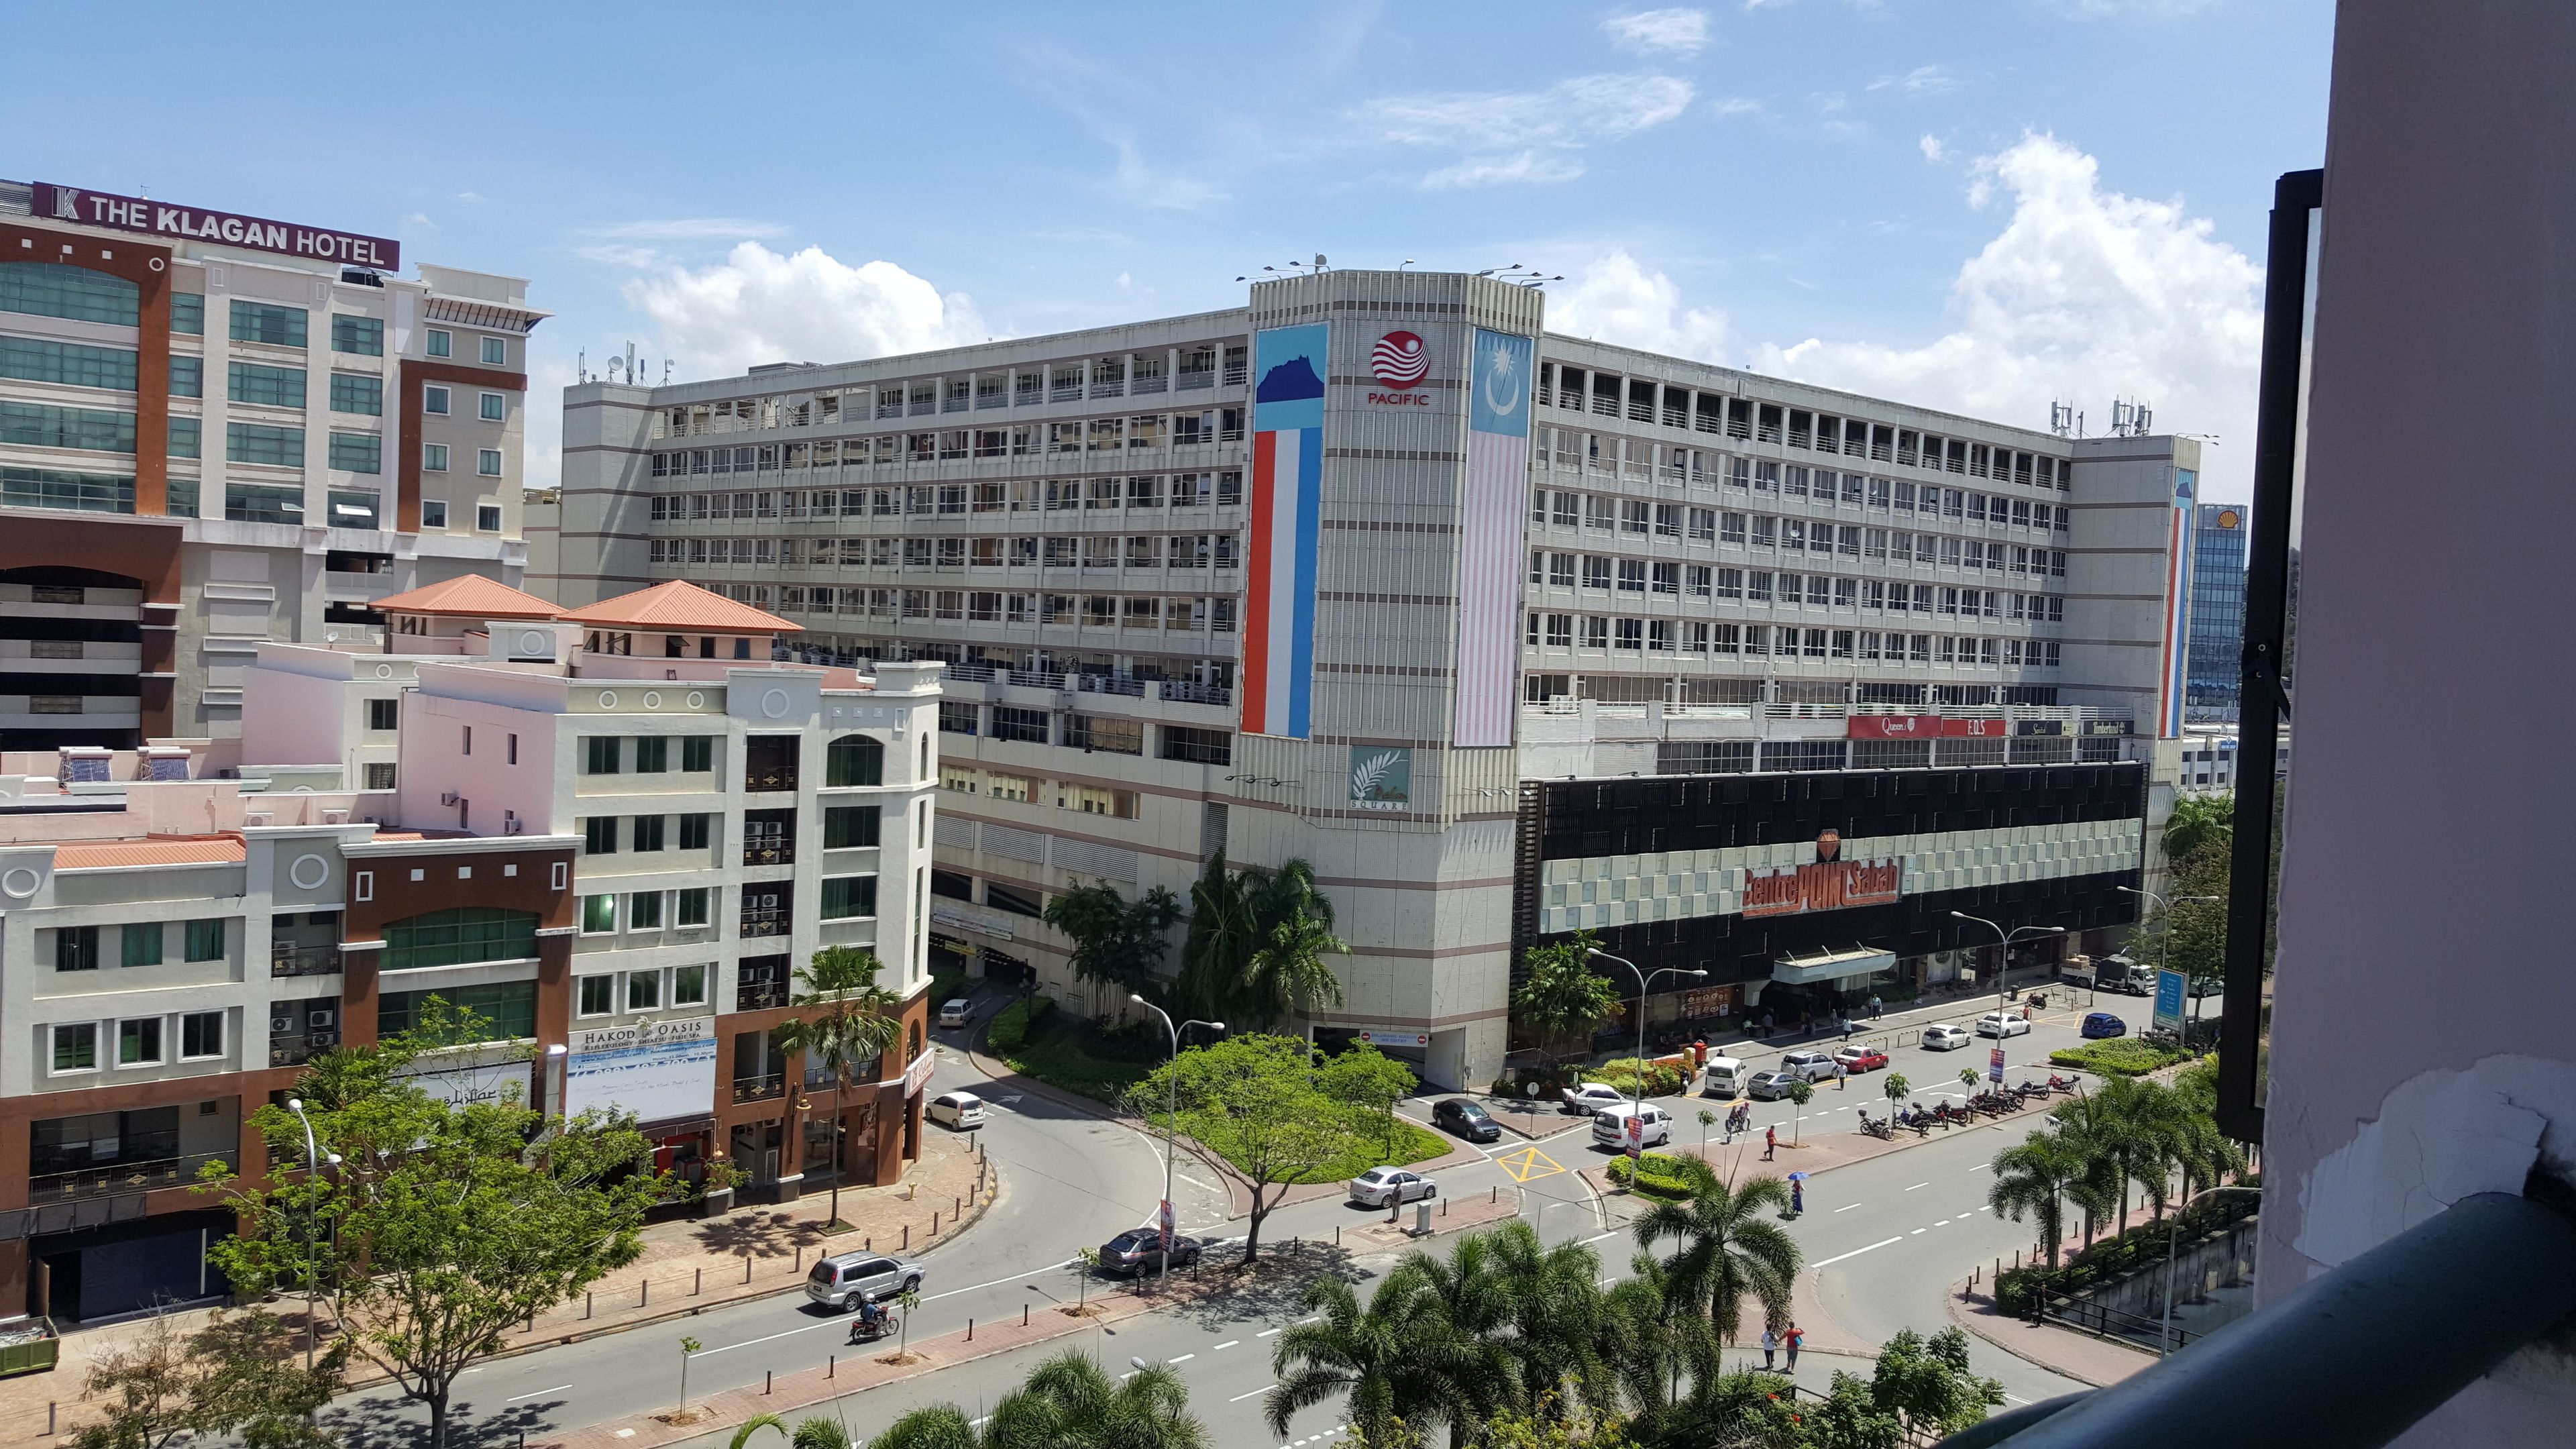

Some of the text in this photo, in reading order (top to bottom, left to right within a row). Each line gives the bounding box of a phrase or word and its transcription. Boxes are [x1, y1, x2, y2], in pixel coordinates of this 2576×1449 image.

[89, 196, 148, 228] THE
[157, 207, 287, 250] KLAGAN
[297, 229, 384, 265] HOTEL
[1368, 392, 1430, 406] PACIFIC
[2093, 721, 2119, 735] Timberland
[1351, 800, 1407, 810] SQUARE
[1849, 858, 1897, 896] Sabah
[584, 1022, 702, 1044] HAKOD OASIS
[584, 1040, 633, 1051] REFLEXOLOGY
[638, 1037, 667, 1045] SHIATSU
